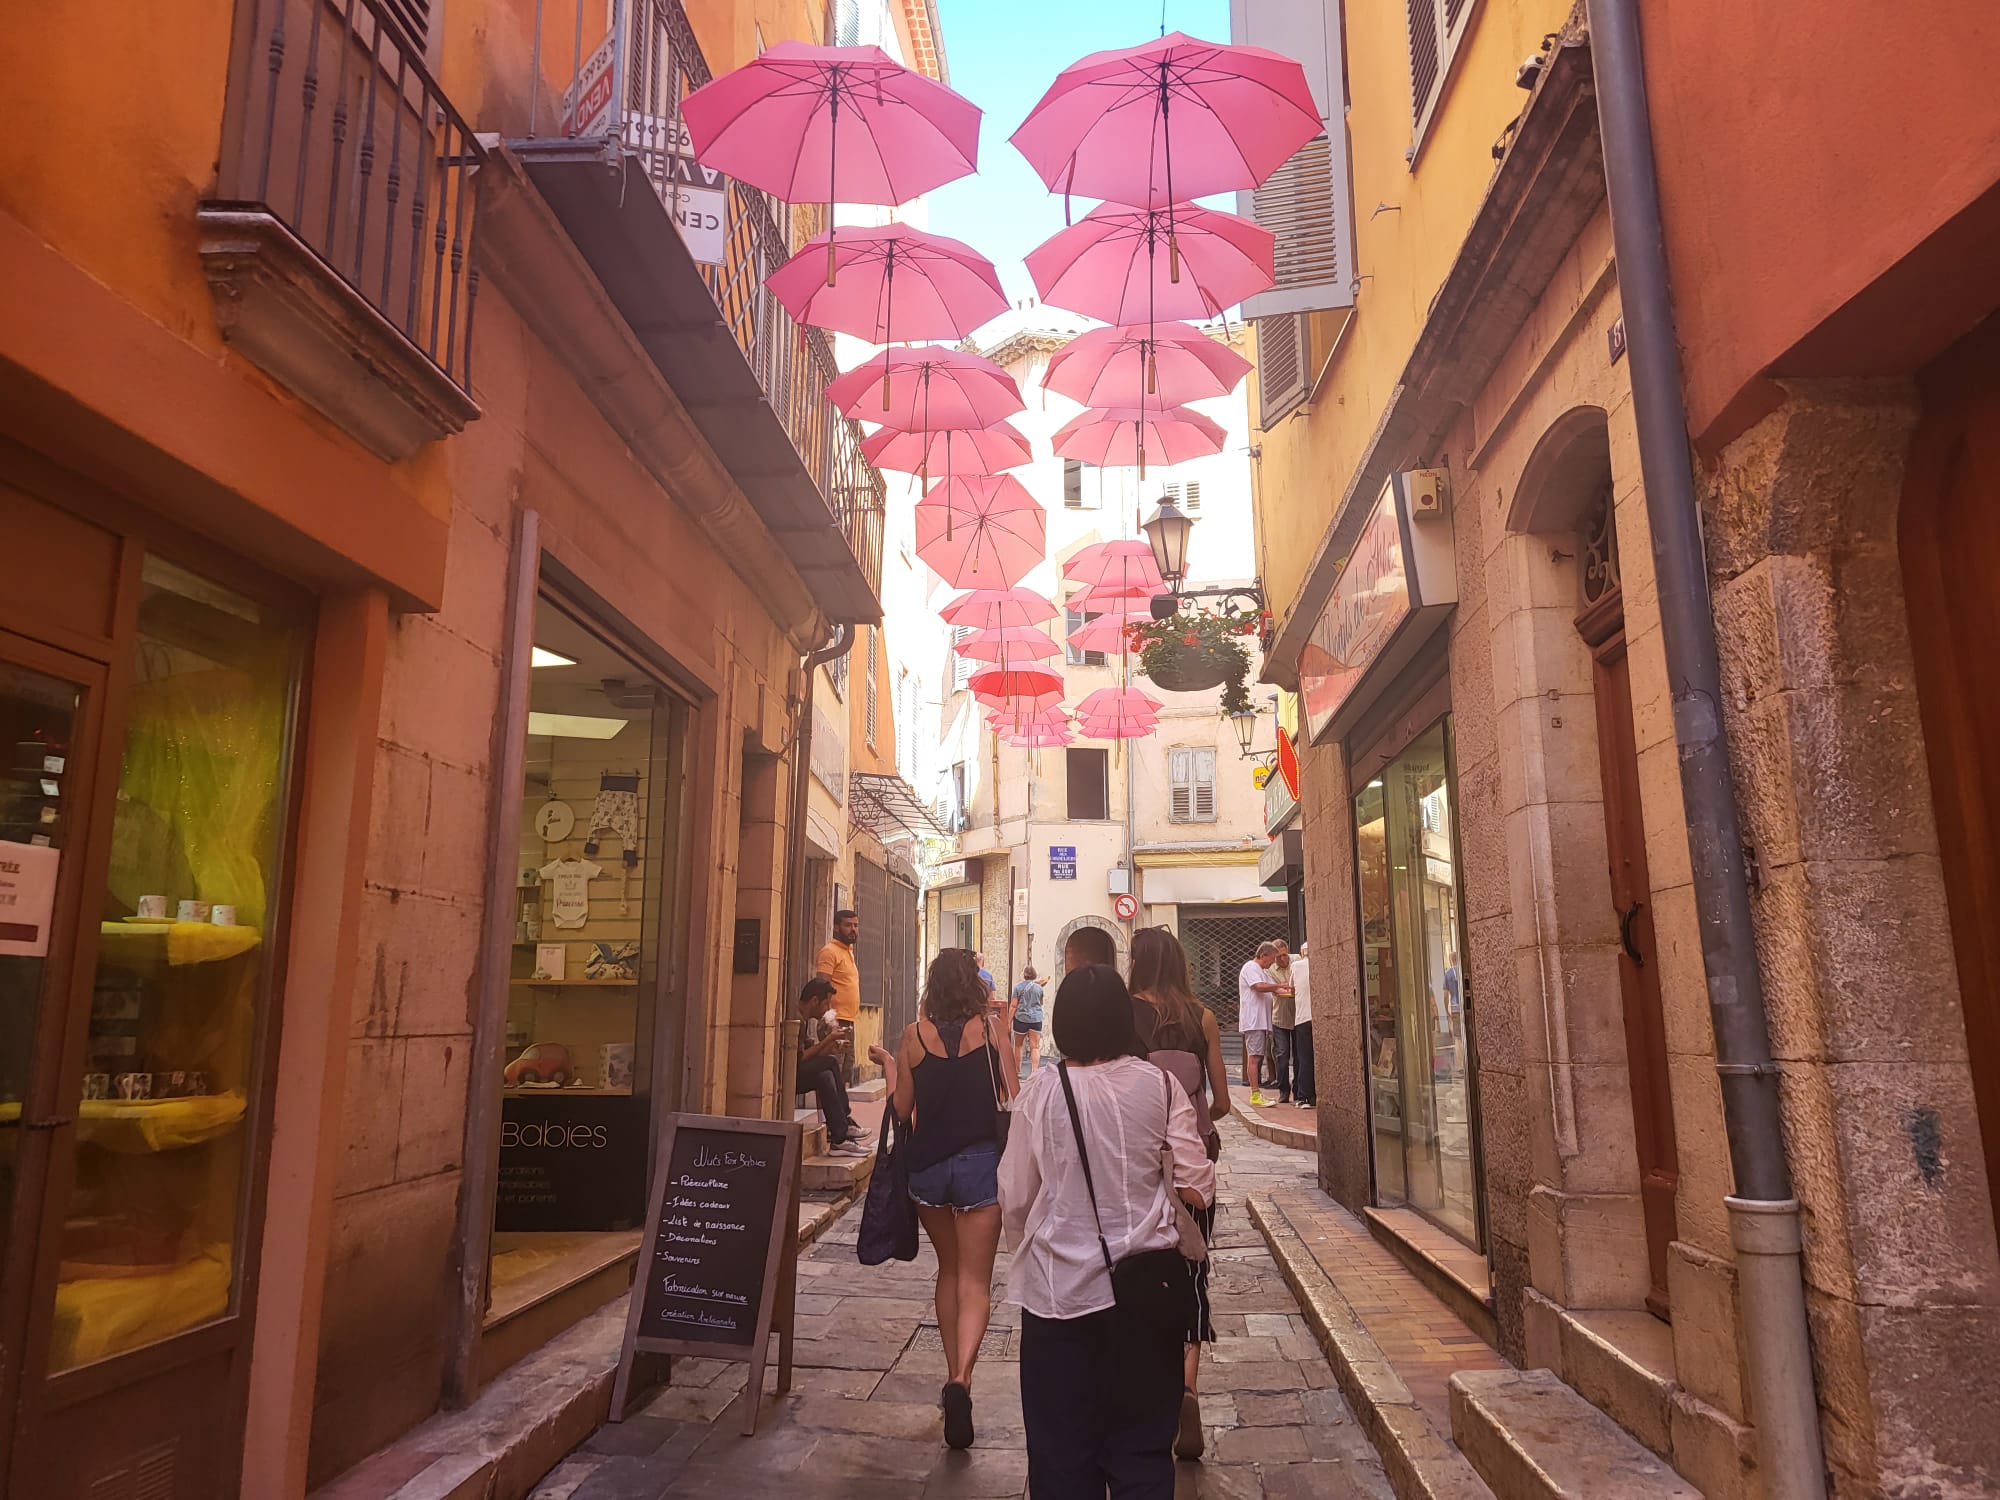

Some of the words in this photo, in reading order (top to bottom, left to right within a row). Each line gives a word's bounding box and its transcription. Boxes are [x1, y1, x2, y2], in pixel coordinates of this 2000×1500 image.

[501, 1120, 607, 1148] Babies
[694, 1145, 721, 1167] Nuts
[736, 1153, 767, 1170] Babies
[672, 1195, 697, 1208] Idées
[700, 1199, 731, 1209] cadeaux
[694, 1219, 702, 1228] de
[705, 1221, 746, 1231] naissance
[661, 1250, 701, 1265] Souvenirs
[663, 1273, 708, 1296] Fabrication
[711, 1289, 724, 1298] sur
